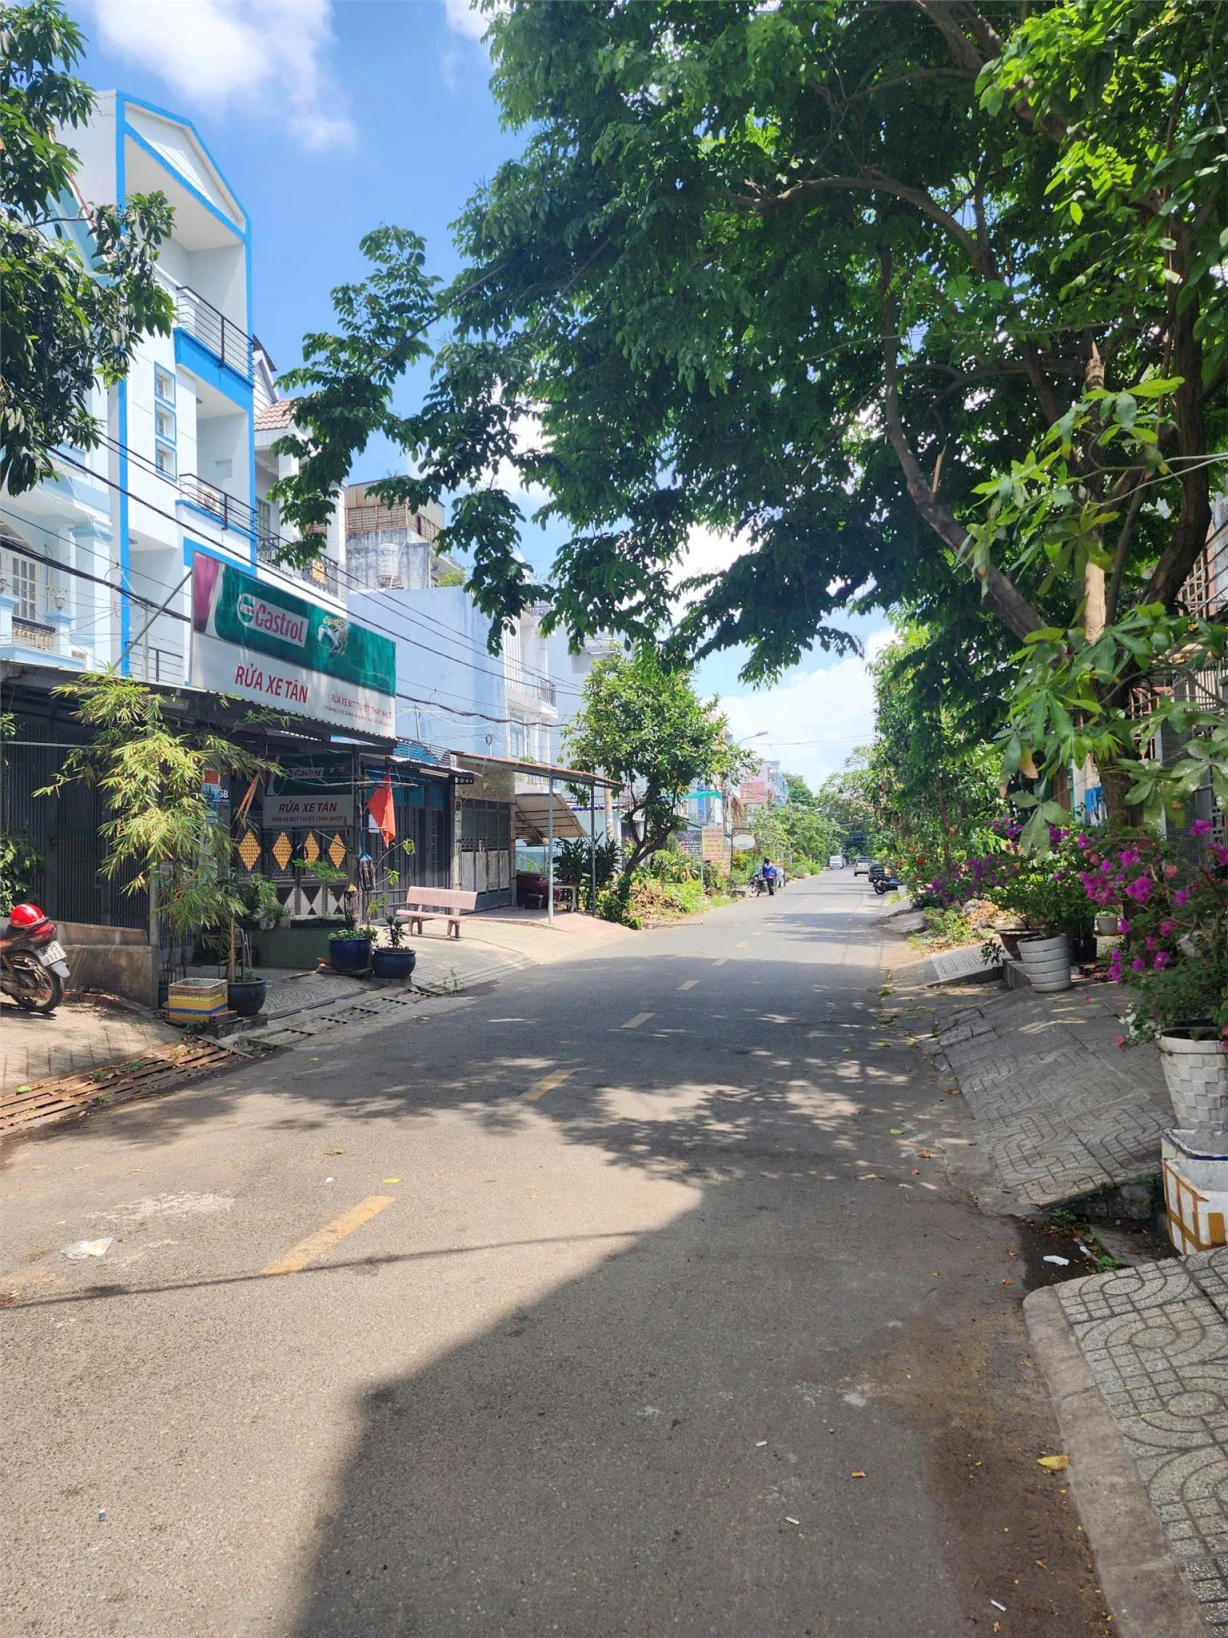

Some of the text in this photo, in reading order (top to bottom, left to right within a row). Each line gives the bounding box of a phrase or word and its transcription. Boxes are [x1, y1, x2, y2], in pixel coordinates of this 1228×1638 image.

[255, 603, 303, 643] Castrol
[235, 663, 309, 704] RỬA XE TÂN
[341, 698, 348, 707] XE
[294, 768, 321, 778] Castrol
[278, 800, 338, 813] RỬA XE TÂN
